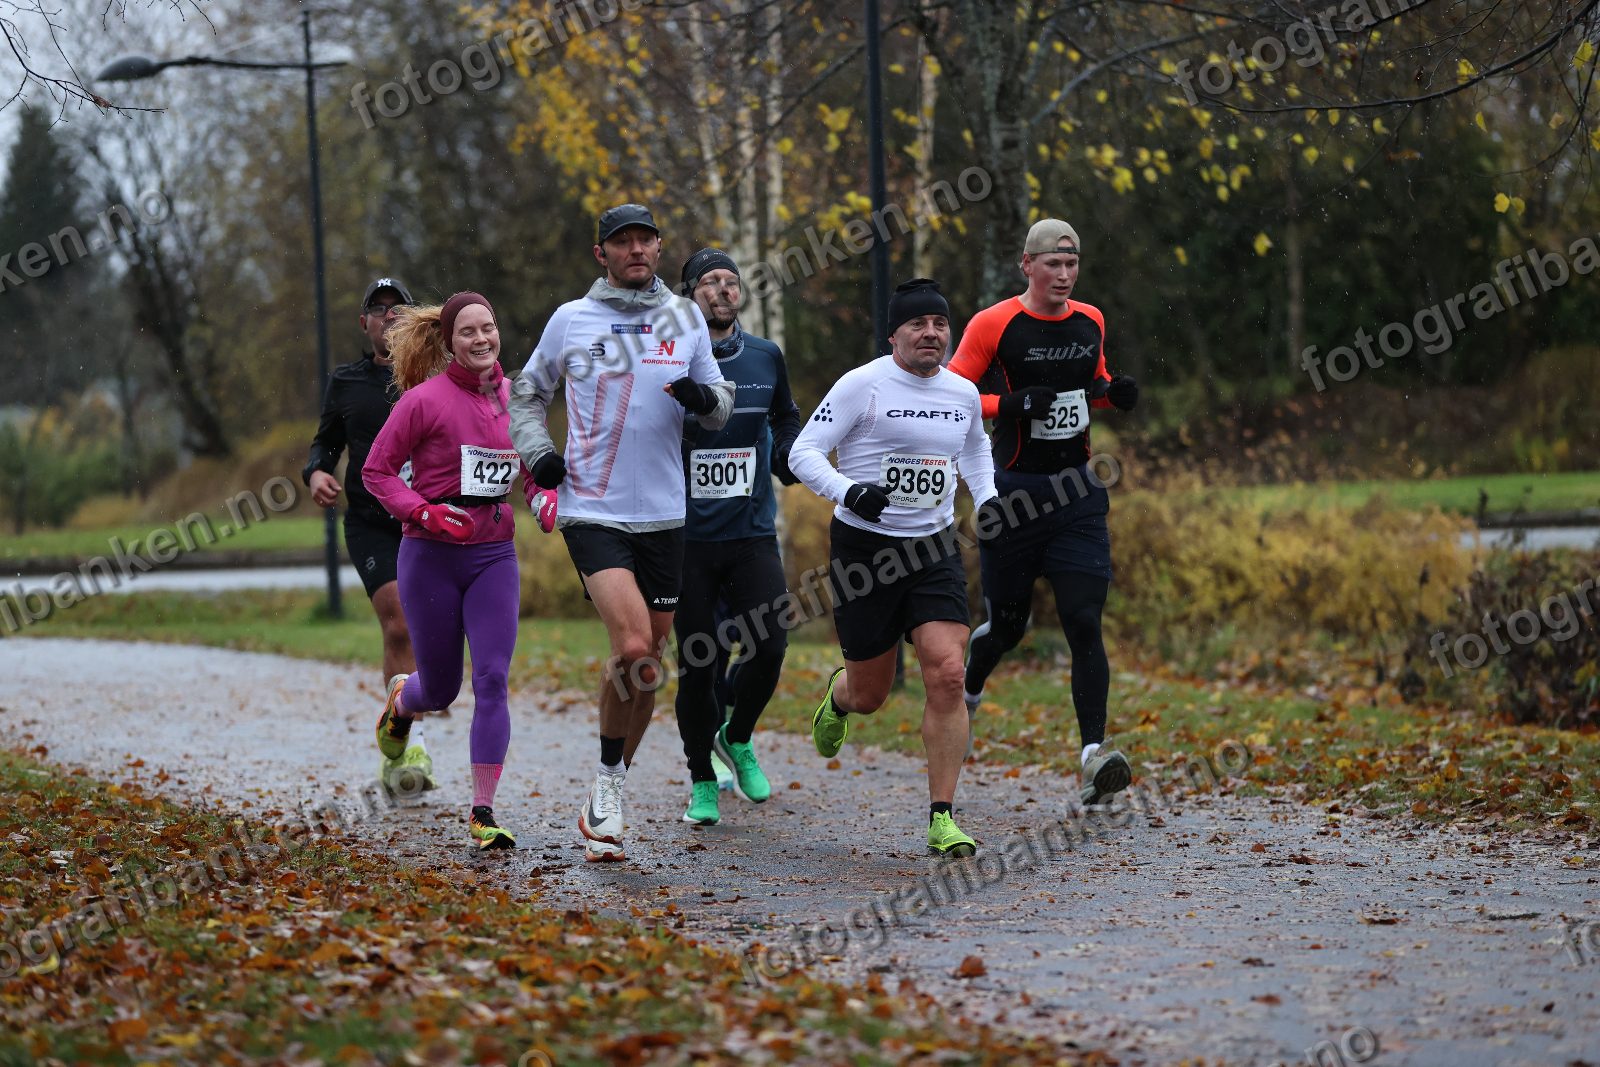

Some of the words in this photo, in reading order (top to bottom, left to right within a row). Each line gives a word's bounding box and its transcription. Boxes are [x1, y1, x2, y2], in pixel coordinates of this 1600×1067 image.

[886, 410, 952, 419] CRAFT
[1044, 405, 1080, 430] 525
[473, 460, 512, 484] 422
[887, 457, 947, 465] NORGESTESTEN
[696, 461, 748, 486] 3001
[885, 467, 945, 495] 9369
